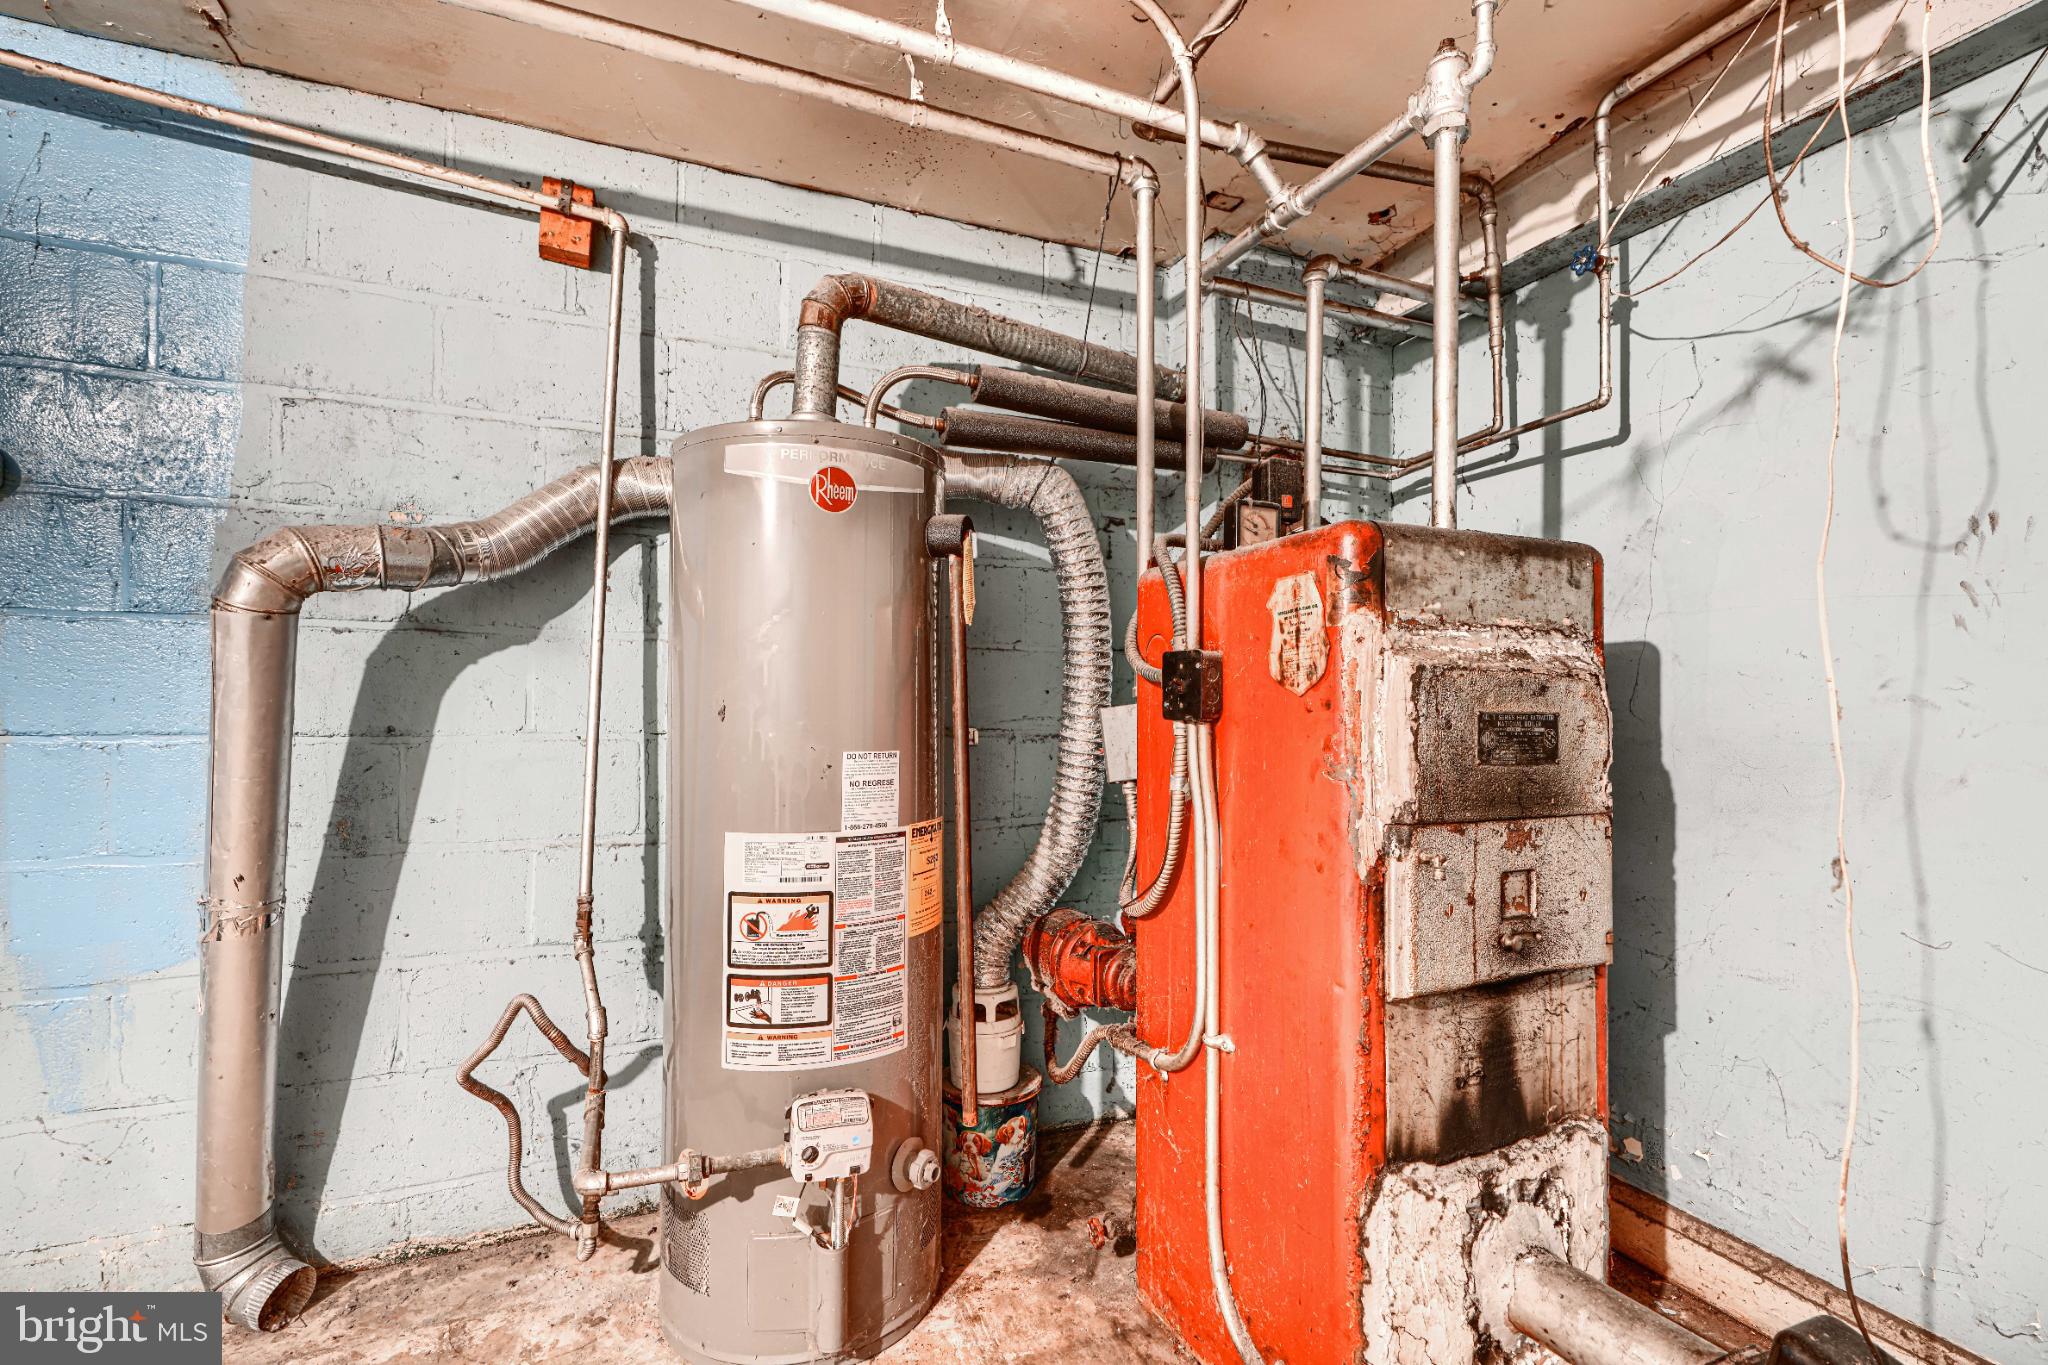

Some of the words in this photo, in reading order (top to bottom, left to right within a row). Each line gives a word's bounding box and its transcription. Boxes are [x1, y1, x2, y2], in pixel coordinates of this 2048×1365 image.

[815, 466, 855, 506] Rheem
[846, 752, 857, 760] DO
[858, 752, 872, 760] NOT
[873, 751, 898, 760] RETURN
[849, 780, 860, 788] NO
[862, 778, 895, 787] REGRESE
